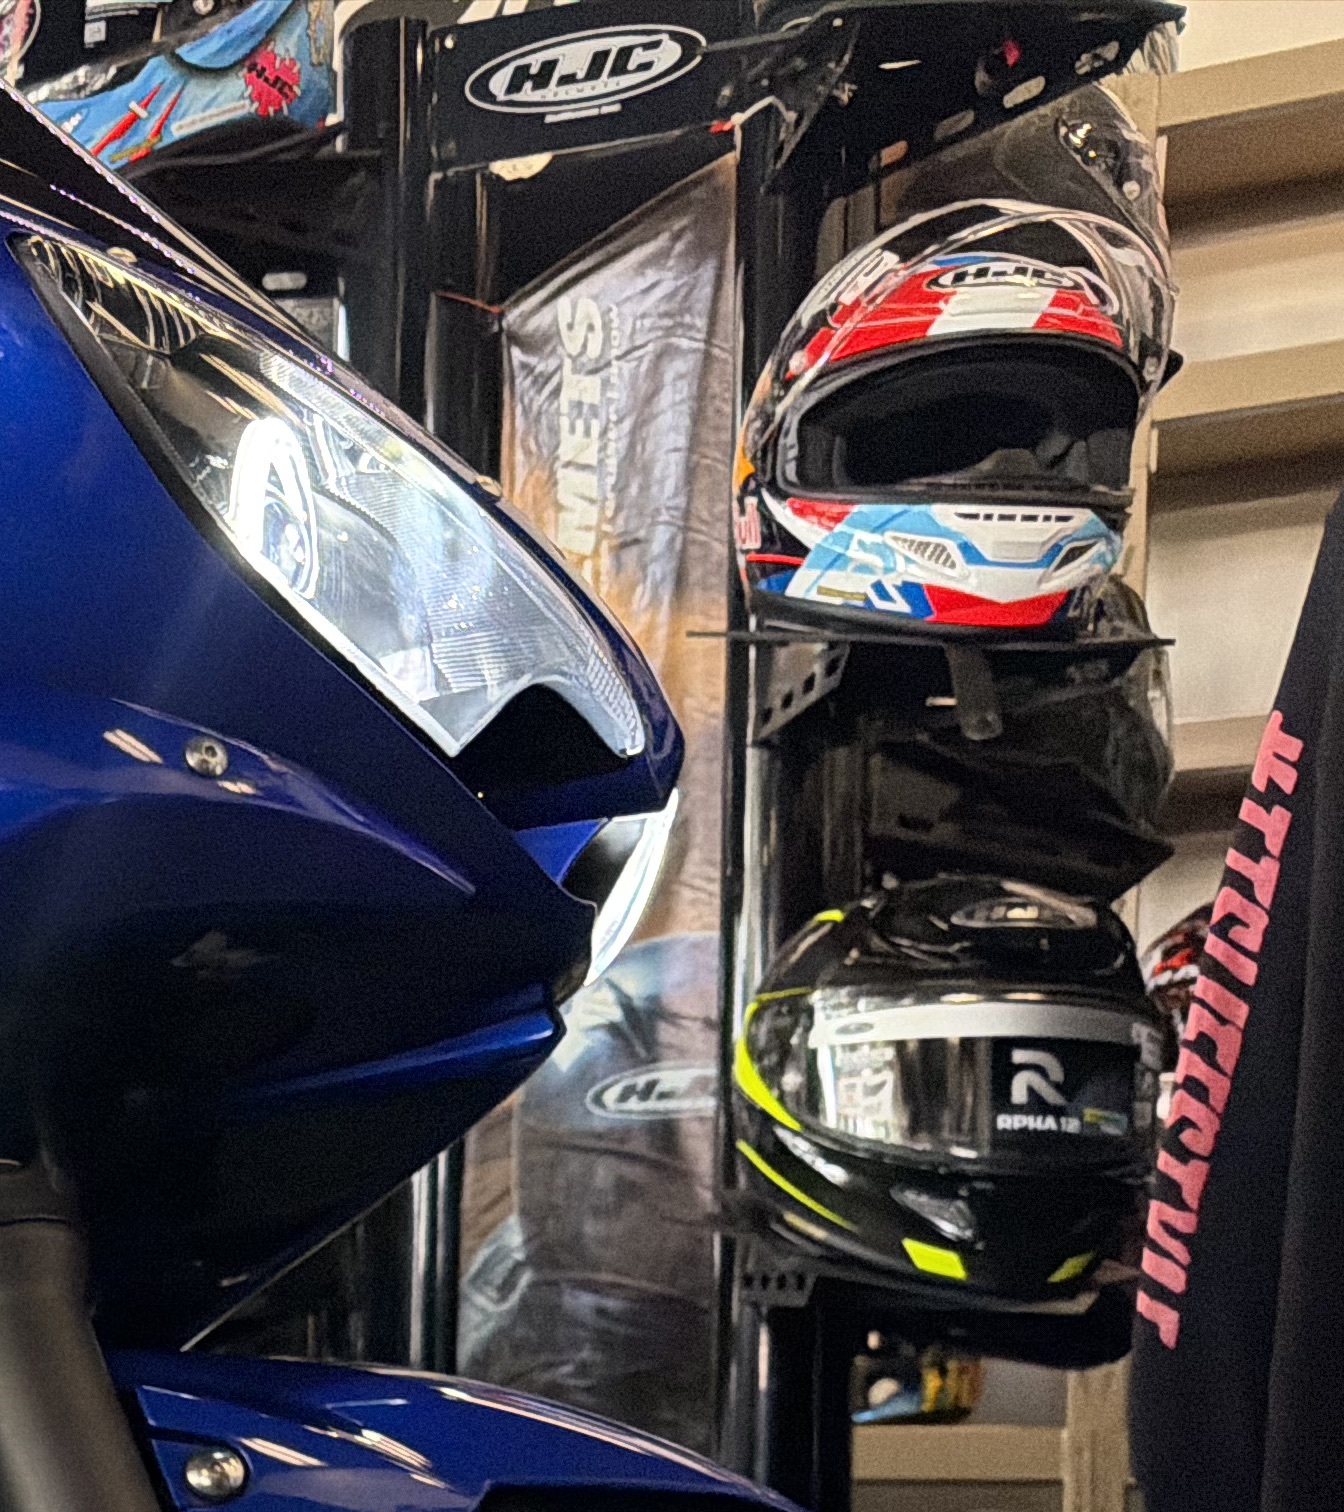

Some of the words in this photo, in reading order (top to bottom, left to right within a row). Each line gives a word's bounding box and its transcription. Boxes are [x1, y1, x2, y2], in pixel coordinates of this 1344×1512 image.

[503, 37, 665, 97] HJC
[950, 265, 1064, 286] HJC
[558, 298, 603, 570] METS
[996, 1113, 1059, 1132] RPHA
